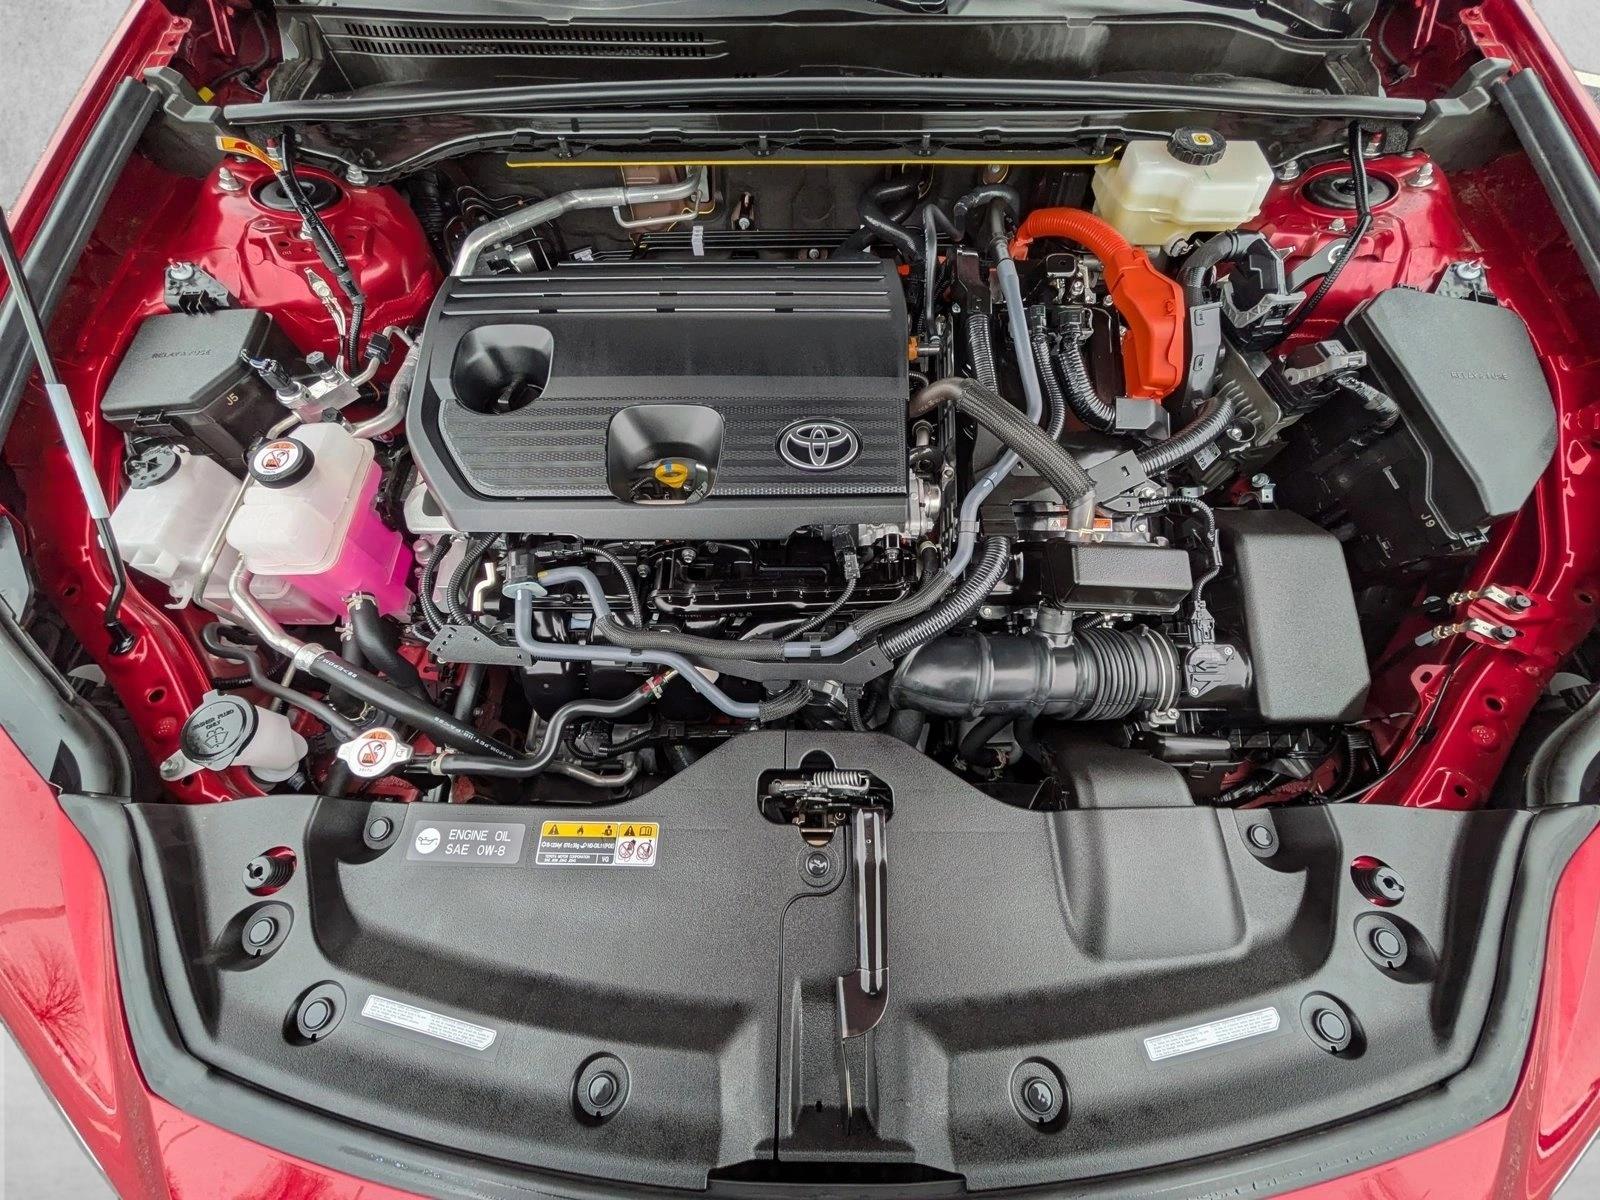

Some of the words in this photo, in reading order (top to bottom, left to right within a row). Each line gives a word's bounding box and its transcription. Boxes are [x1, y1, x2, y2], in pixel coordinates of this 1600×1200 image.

[226, 392, 239, 406] J5
[1420, 513, 1435, 528] J9
[448, 829, 489, 841] ENGINE
[494, 830, 512, 842] OIL
[445, 843, 470, 855] SAE
[476, 844, 506, 857] 0W-8
